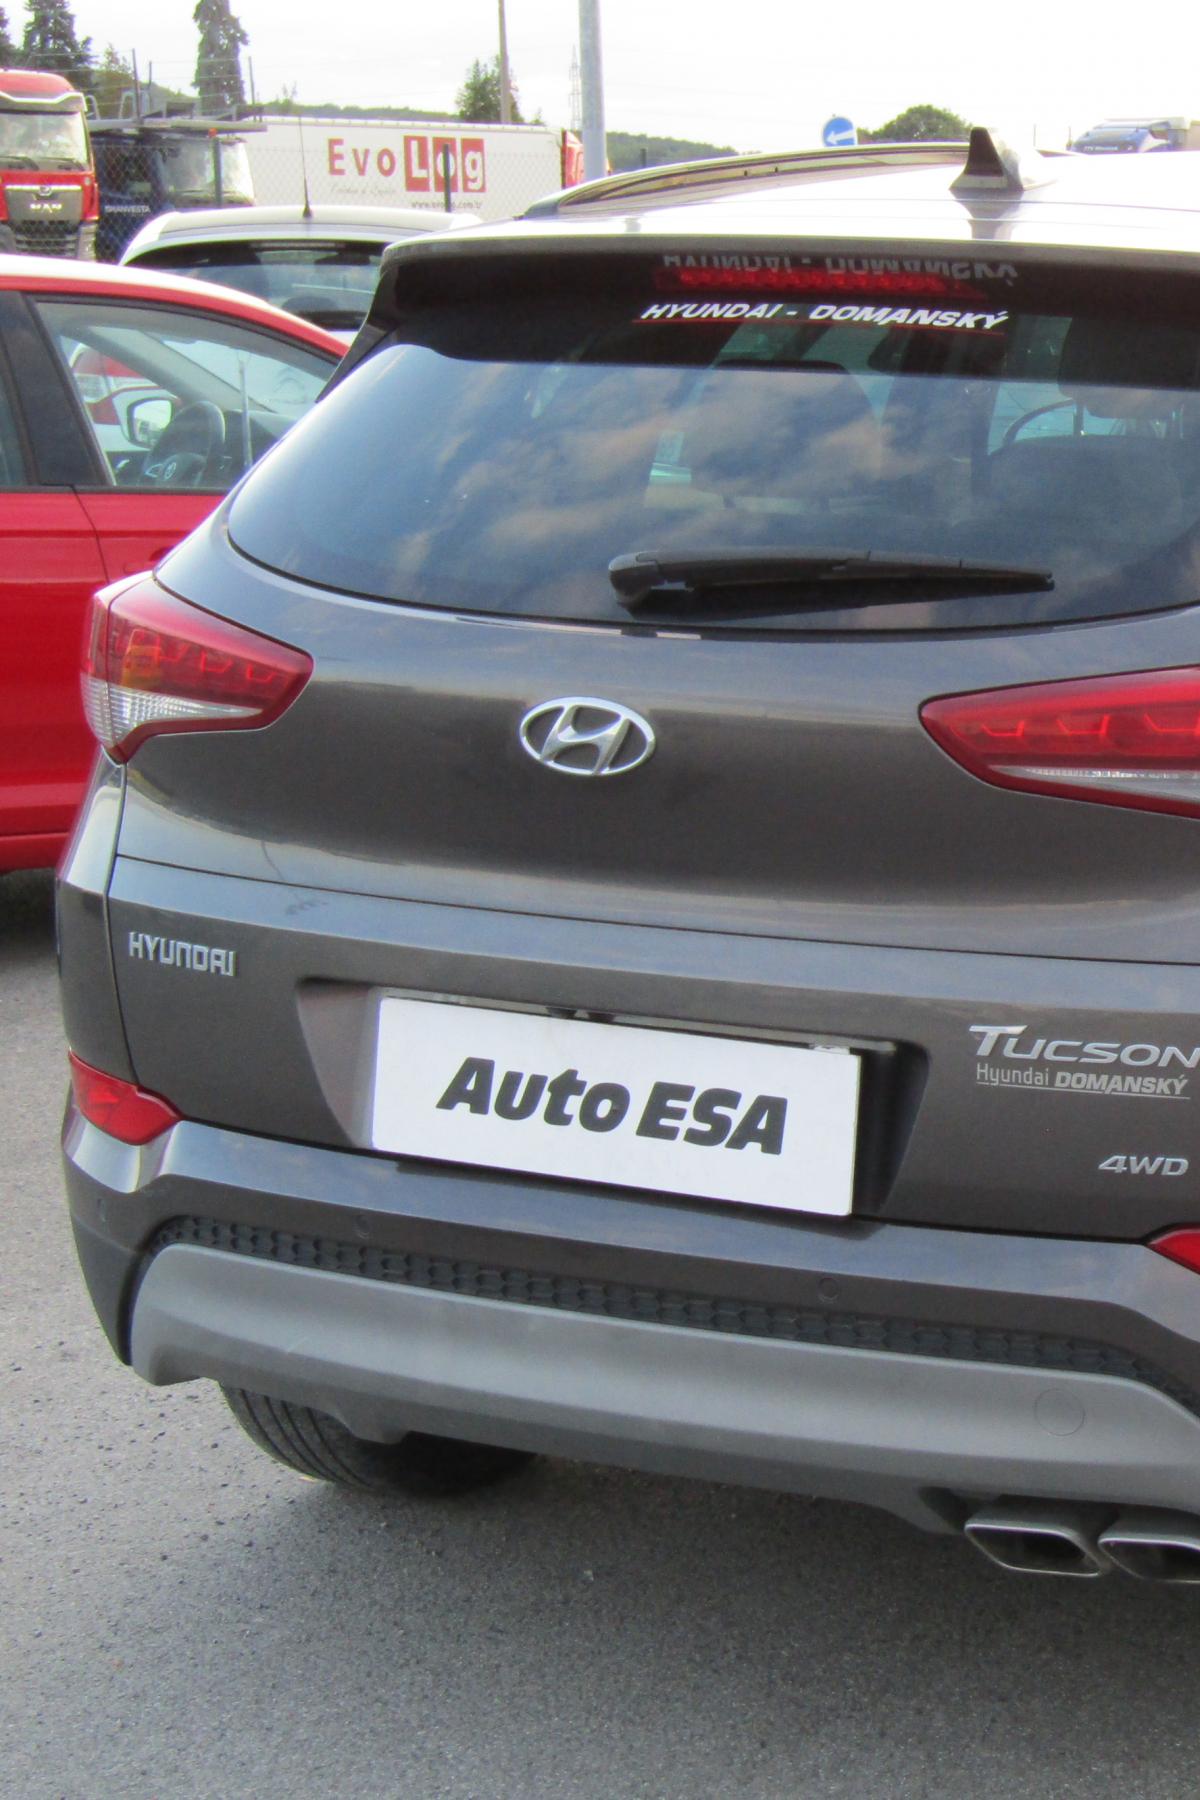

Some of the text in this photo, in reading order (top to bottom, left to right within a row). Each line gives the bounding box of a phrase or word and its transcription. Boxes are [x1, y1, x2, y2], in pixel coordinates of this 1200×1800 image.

[640, 303, 783, 320] HYUNDAI
[808, 304, 1010, 330] DOMANSKÝ
[128, 931, 238, 977] HYUNDAI
[976, 1062, 1189, 1096] Hyundai DOMANSKÝ
[435, 1056, 789, 1156] Auto ESA
[1097, 1154, 1190, 1177] 4WD
